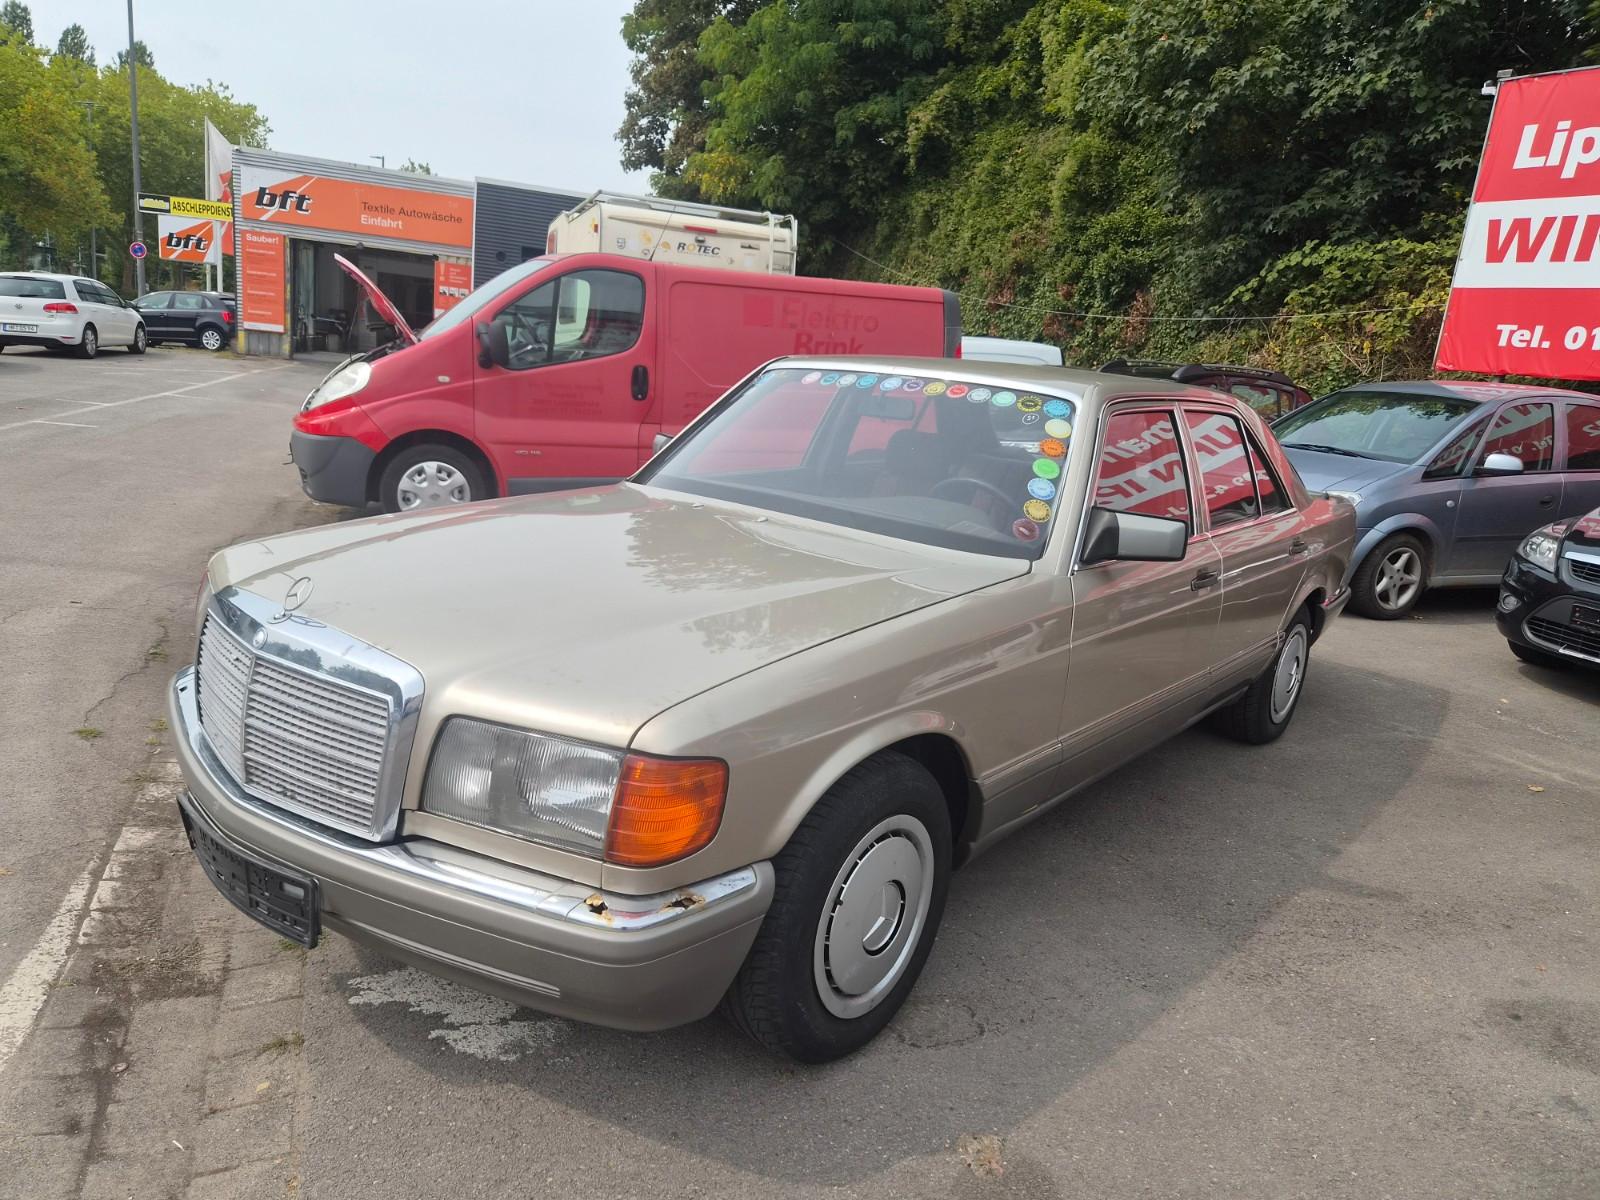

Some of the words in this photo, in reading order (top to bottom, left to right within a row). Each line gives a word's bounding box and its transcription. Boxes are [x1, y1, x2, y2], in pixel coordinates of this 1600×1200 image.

[255, 186, 312, 215] bft
[361, 201, 396, 215] Textile
[398, 207, 463, 223] Autowäsche
[361, 214, 403, 229] Einfahrt
[166, 232, 208, 252] bft
[676, 242, 720, 255] ROTEC
[781, 297, 879, 333] Elektro
[794, 330, 864, 354] Brink
[1496, 324, 1551, 349] Tel.
